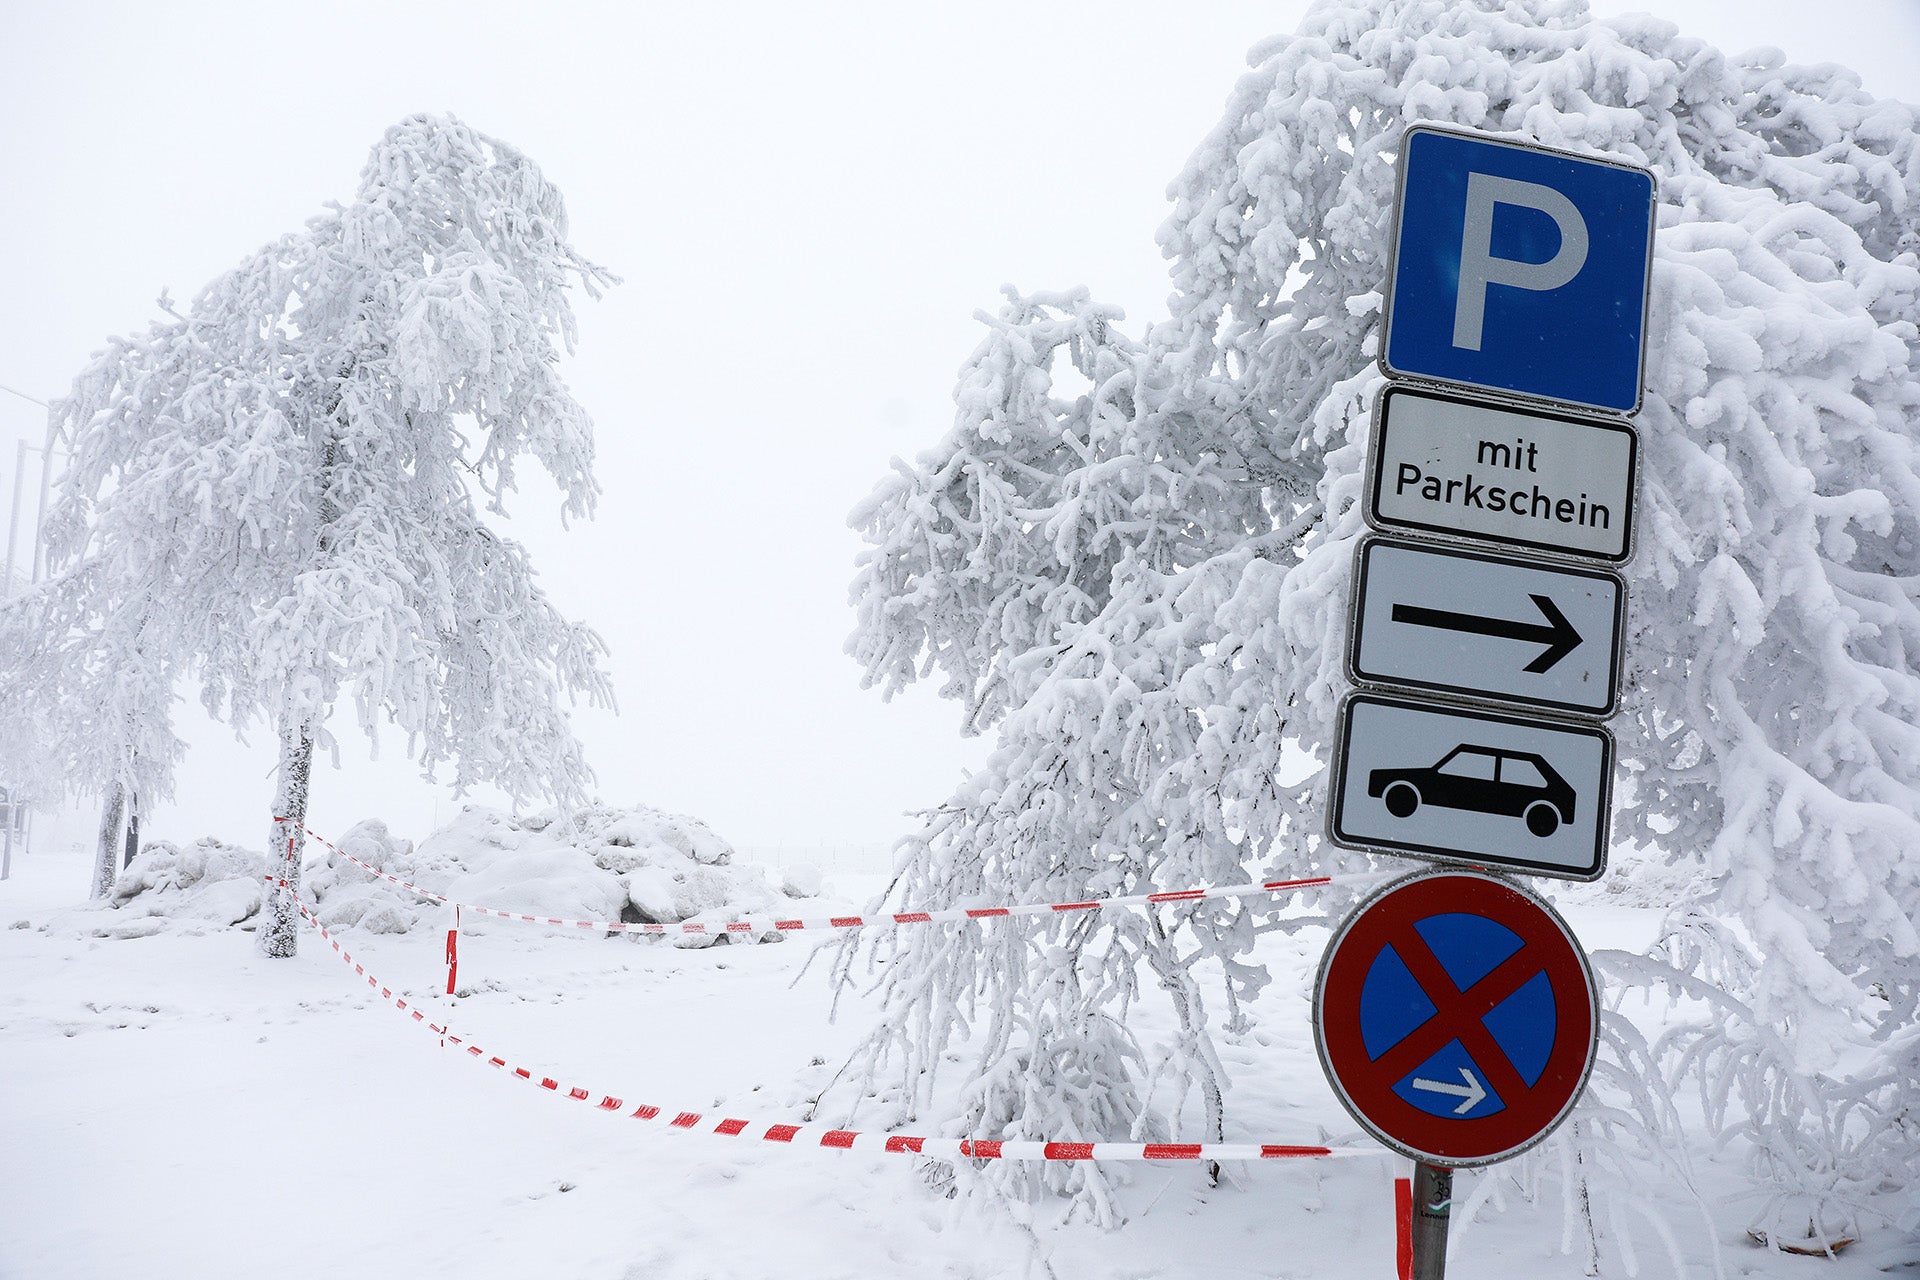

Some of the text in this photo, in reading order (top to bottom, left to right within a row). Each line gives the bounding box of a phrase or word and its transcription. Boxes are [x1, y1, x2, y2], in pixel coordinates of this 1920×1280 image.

[1452, 171, 1589, 352] P
[1477, 438, 1539, 473] mit
[1396, 462, 1610, 530] Parkschein
